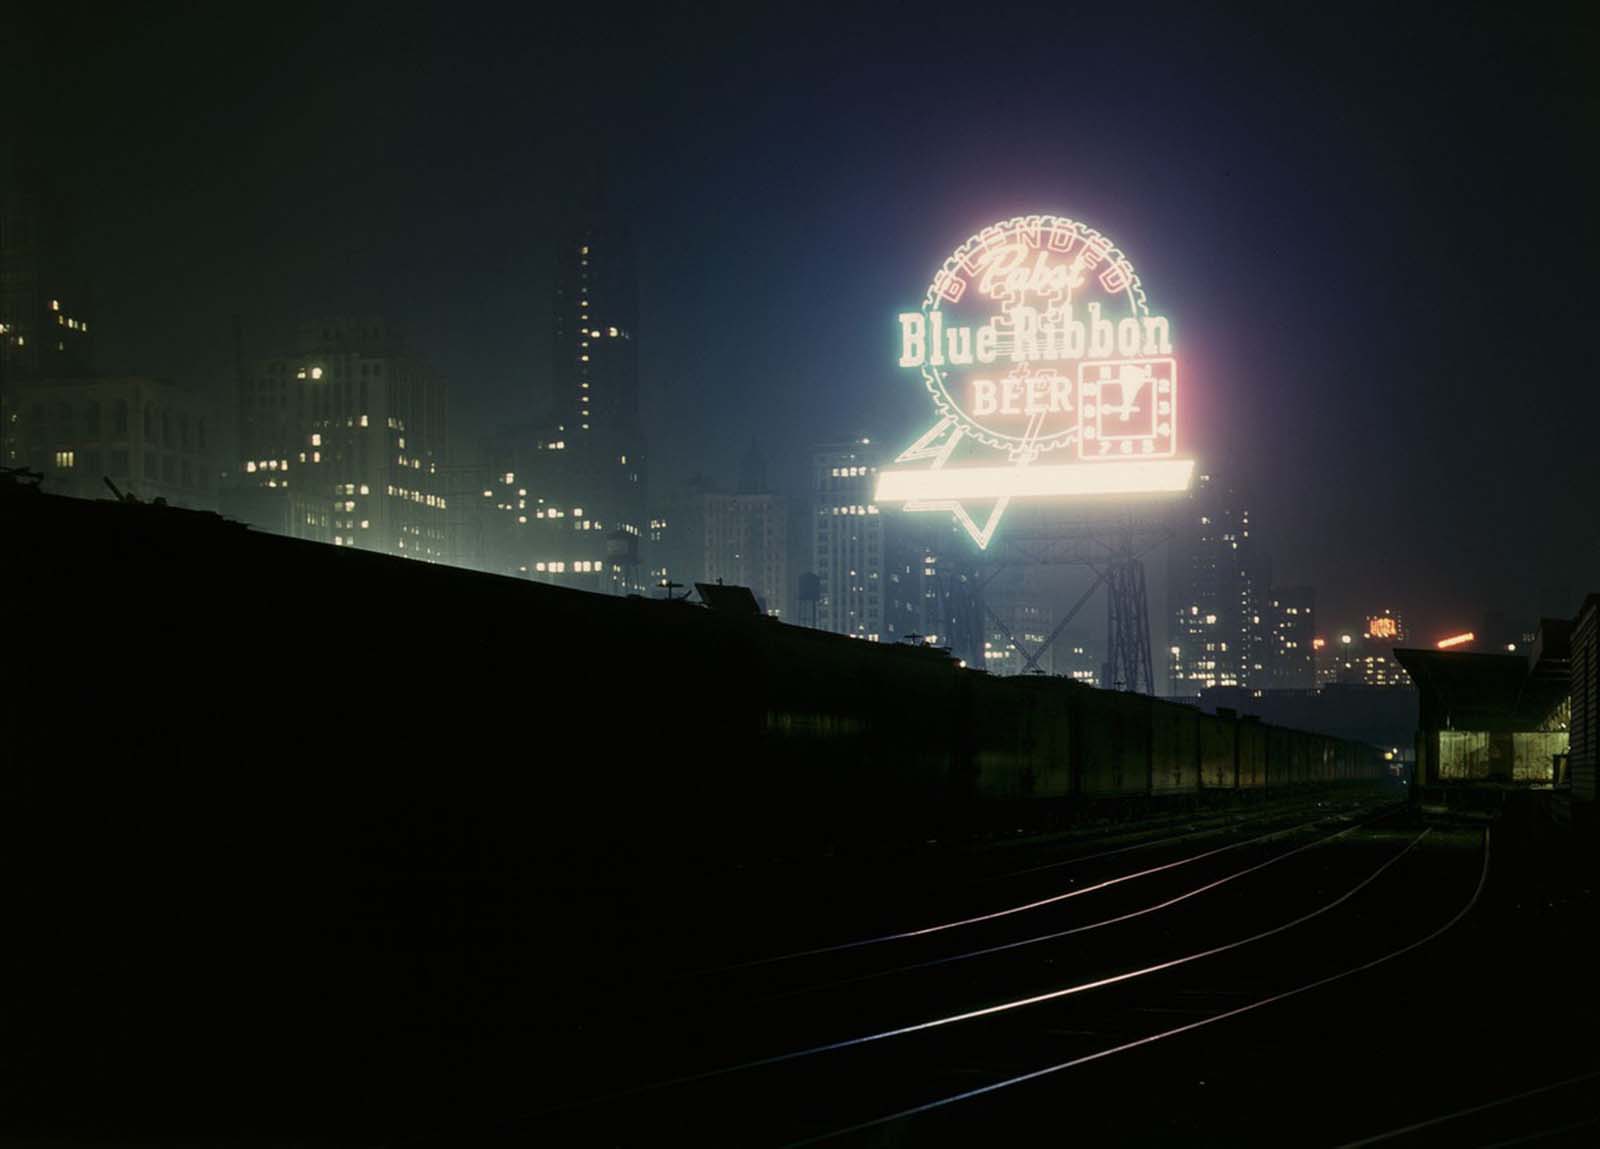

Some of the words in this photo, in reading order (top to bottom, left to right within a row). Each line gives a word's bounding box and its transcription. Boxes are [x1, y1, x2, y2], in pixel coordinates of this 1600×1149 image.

[934, 220, 1131, 303] BLENDED
[979, 245, 1088, 295] Pabst
[899, 312, 998, 368] Blue
[1010, 302, 1173, 363] Ribbon
[972, 376, 1073, 416] BEER
